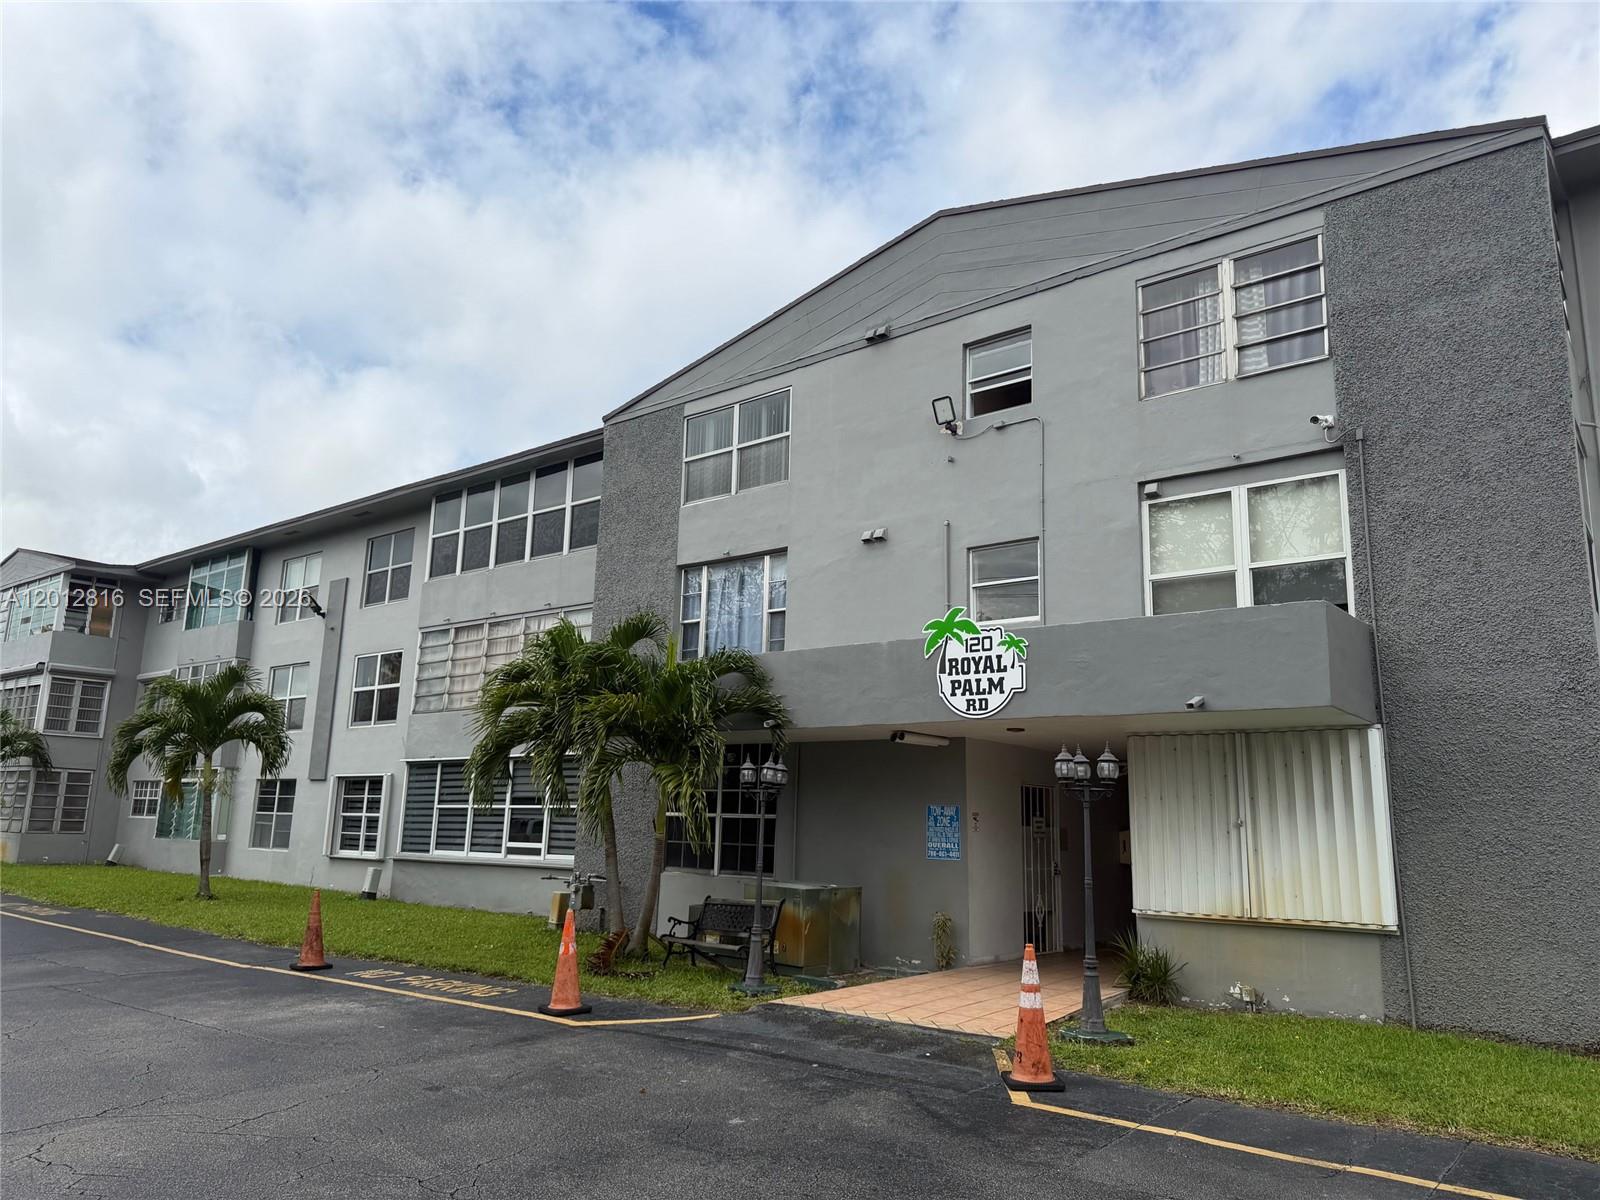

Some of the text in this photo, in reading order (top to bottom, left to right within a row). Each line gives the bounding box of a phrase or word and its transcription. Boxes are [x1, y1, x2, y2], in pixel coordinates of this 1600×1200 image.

[965, 635, 993, 653] 120
[948, 655, 1007, 676] ROYAL
[950, 676, 1005, 697] PALM
[965, 698, 989, 712] RD
[936, 815, 951, 827] ZONE
